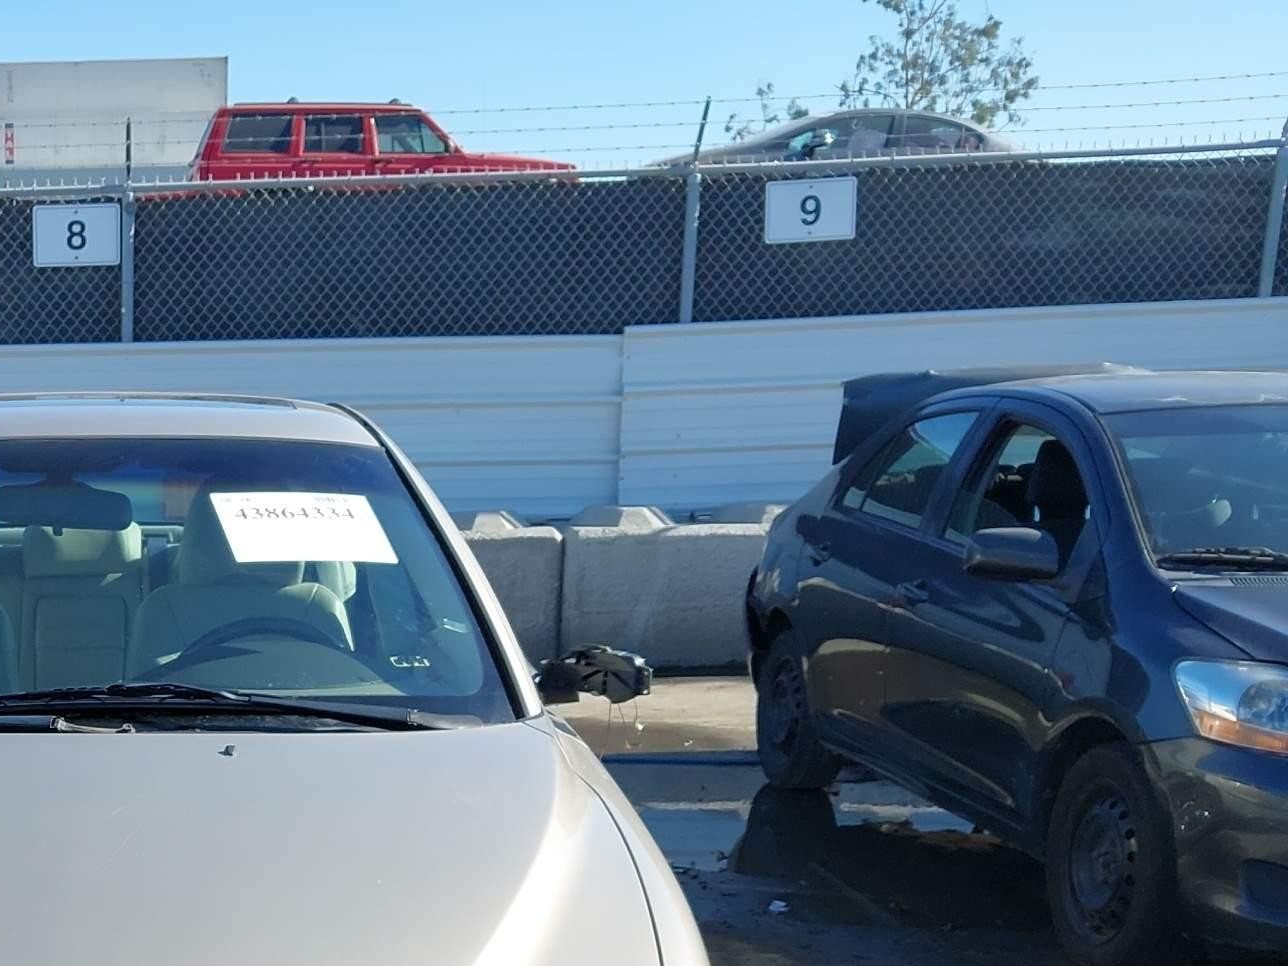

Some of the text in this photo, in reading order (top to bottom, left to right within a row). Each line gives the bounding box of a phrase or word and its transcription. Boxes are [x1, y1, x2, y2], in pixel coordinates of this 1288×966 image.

[800, 196, 822, 226] 9
[66, 220, 87, 251] 8
[234, 507, 355, 520] 43864334
